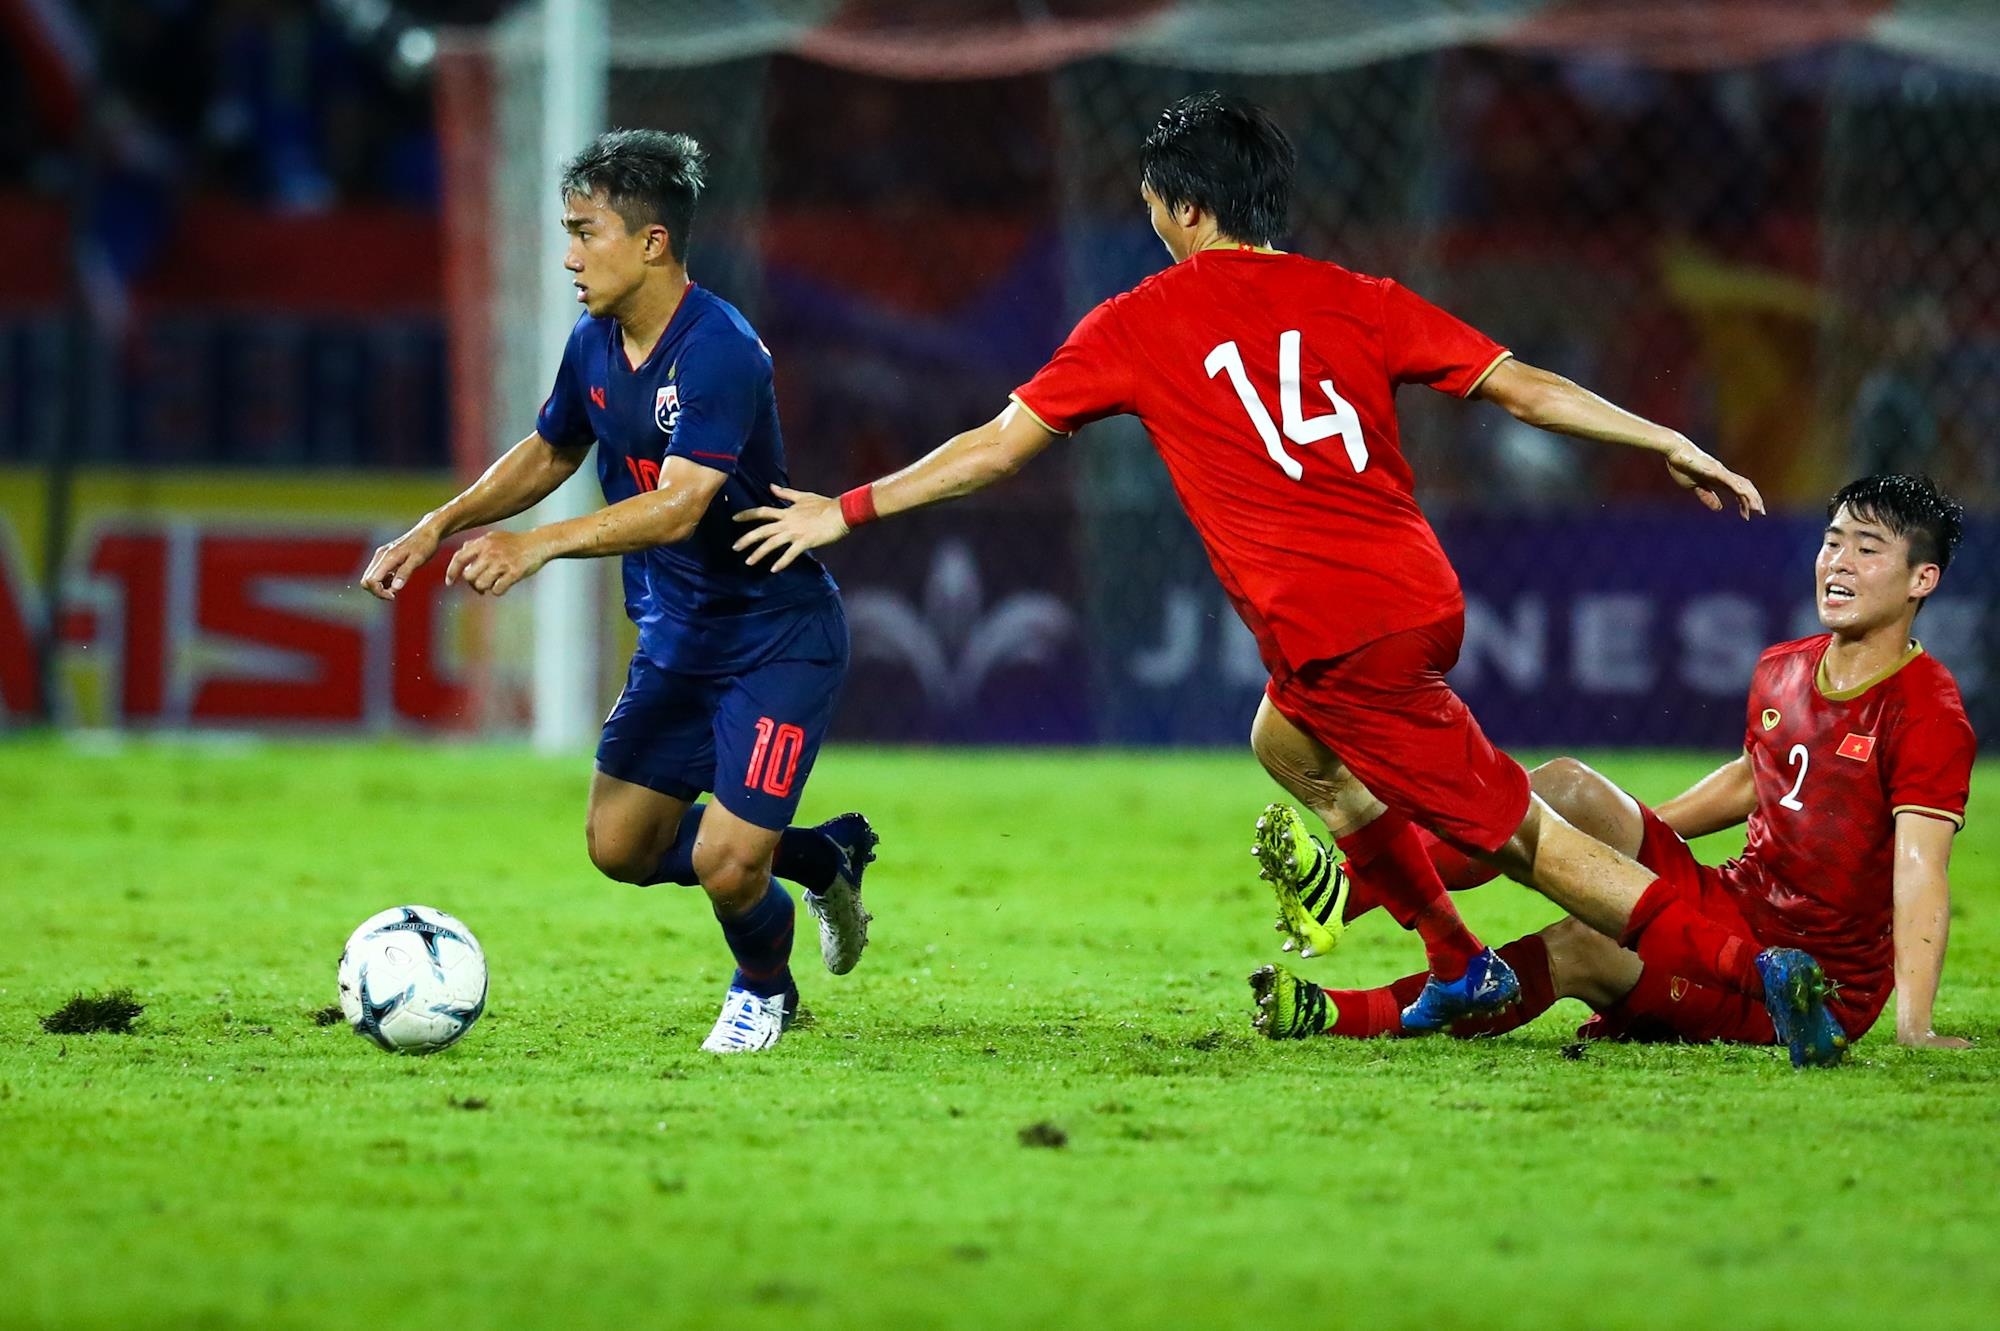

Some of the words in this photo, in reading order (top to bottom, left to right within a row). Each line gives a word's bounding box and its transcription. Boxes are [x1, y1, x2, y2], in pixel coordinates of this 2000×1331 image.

[1203, 329, 1369, 481] 14
[744, 716, 804, 798] 10
[1778, 743, 1810, 811] 2
